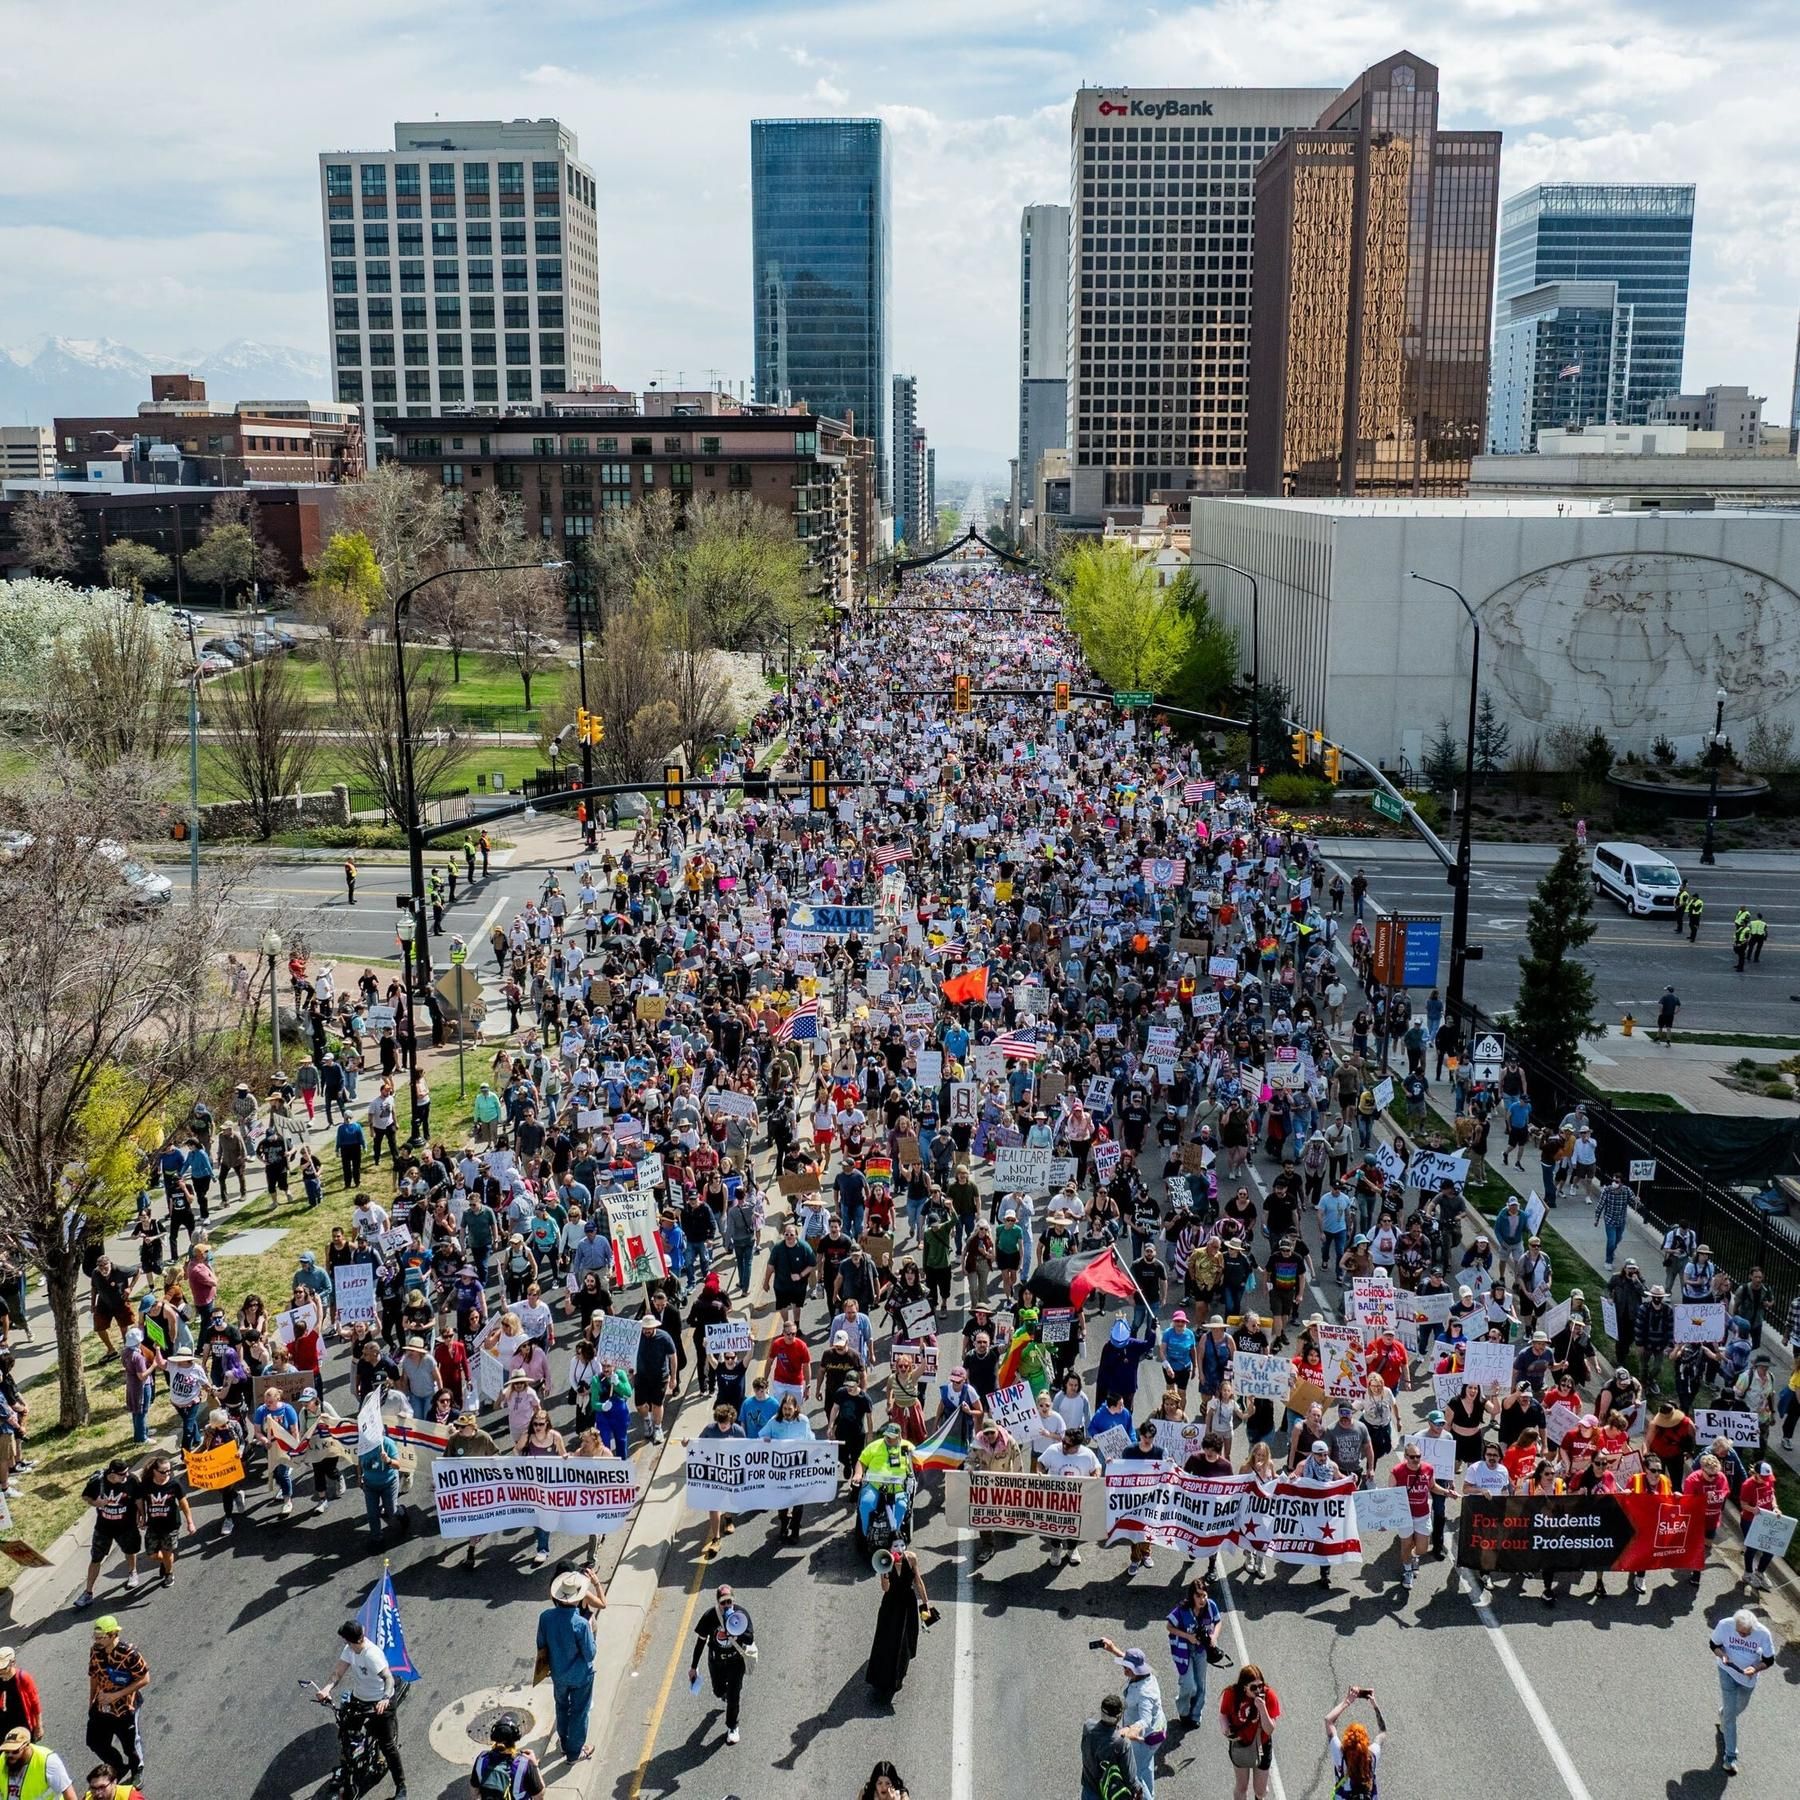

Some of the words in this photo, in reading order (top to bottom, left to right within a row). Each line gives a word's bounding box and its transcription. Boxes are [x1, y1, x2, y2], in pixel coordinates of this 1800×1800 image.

[1130, 100, 1213, 120] KeyBank
[817, 908, 870, 927] SALT
[1378, 927, 1386, 967] DOWNTOWN
[1481, 1042, 1498, 1053] 186
[1095, 1079, 1109, 1094] ICE
[1095, 1144, 1119, 1158] PUNKS
[1378, 1146, 1395, 1167] NO
[1009, 1164, 1036, 1175] NOT
[1097, 1155, 1120, 1169] HATE
[605, 1193, 648, 1205] THIRSTY
[610, 1208, 648, 1223] JUSTICE
[1355, 1288, 1393, 1298] SCHOOLS
[1364, 1315, 1388, 1325] WAR
[707, 1325, 731, 1336] Donald
[1486, 1343, 1512, 1356] LIKE
[1239, 1356, 1257, 1372] WE
[1265, 1357, 1287, 1372] ARE
[1252, 1370, 1269, 1381] THE
[172, 1382, 193, 1393] KINGS
[1240, 1380, 1281, 1395] PEOPLE
[1329, 1387, 1347, 1397] ICE
[1349, 1388, 1366, 1399] OUT
[987, 1384, 1025, 1408] TRUMP
[1001, 1404, 1010, 1416] IS
[1012, 1402, 1019, 1412] A
[715, 1452, 726, 1466] IT
[729, 1453, 741, 1468] IS
[745, 1452, 769, 1466] OUR
[772, 1451, 806, 1467] DUTY
[438, 1470, 459, 1489] NO
[461, 1466, 502, 1485] KINGS
[503, 1467, 514, 1480] &
[516, 1465, 535, 1481] NO
[536, 1466, 630, 1485] BILLIONAIRES!
[689, 1465, 705, 1479] TO
[707, 1466, 743, 1484] FIGHT
[748, 1470, 766, 1481] FOR
[768, 1469, 787, 1481] OUR
[789, 1467, 836, 1480] FREEDOM!
[711, 1484, 733, 1493] SOCIALISM
[740, 1484, 765, 1493] LIBERATION
[1028, 1479, 1066, 1491] MEMBERS
[1067, 1481, 1083, 1494] SAY
[1108, 1477, 1121, 1486] FOR
[1123, 1476, 1136, 1486] THE
[1182, 1481, 1207, 1493] PEOPLE
[1208, 1484, 1223, 1494] AND
[438, 1493, 461, 1511] WE
[462, 1488, 495, 1508] NEED
[497, 1487, 506, 1504] A
[507, 1486, 546, 1506] WHOLE
[547, 1490, 578, 1507] NEW
[579, 1487, 635, 1507] SYSTEM!
[969, 1487, 988, 1505] NO
[991, 1487, 1022, 1507] WAR
[1025, 1489, 1044, 1509] ON
[1046, 1491, 1081, 1514] IRAN!
[1109, 1489, 1170, 1510] STUDENTS
[1173, 1491, 1210, 1516] FIGHT
[441, 1516, 458, 1525] PARTY
[458, 1515, 467, 1523] FOR
[467, 1511, 495, 1522] SOCIALISM
[495, 1509, 506, 1517] AND
[506, 1507, 536, 1516] LIBERATION
[1324, 1499, 1346, 1518] ICE
[973, 1508, 985, 1516] GET
[986, 1508, 1003, 1517] HELP
[1004, 1510, 1031, 1519] LEAVING
[1032, 1512, 1045, 1521] THE
[1046, 1514, 1076, 1525] MILITARY
[1144, 1507, 1158, 1519] THE
[1160, 1509, 1204, 1531] BILLIONAIRE
[1206, 1519, 1235, 1532] AGENDA
[1472, 1514, 1497, 1528] For
[1502, 1517, 1530, 1528] our
[1533, 1514, 1601, 1528] Students
[971, 1516, 1077, 1534] 800-379-2679
[1659, 1520, 1688, 1531] SLEA
[1471, 1535, 1497, 1550] For
[1501, 1538, 1529, 1550] our
[1532, 1535, 1614, 1550] Profession
[1729, 1636, 1758, 1649] UNPAID
